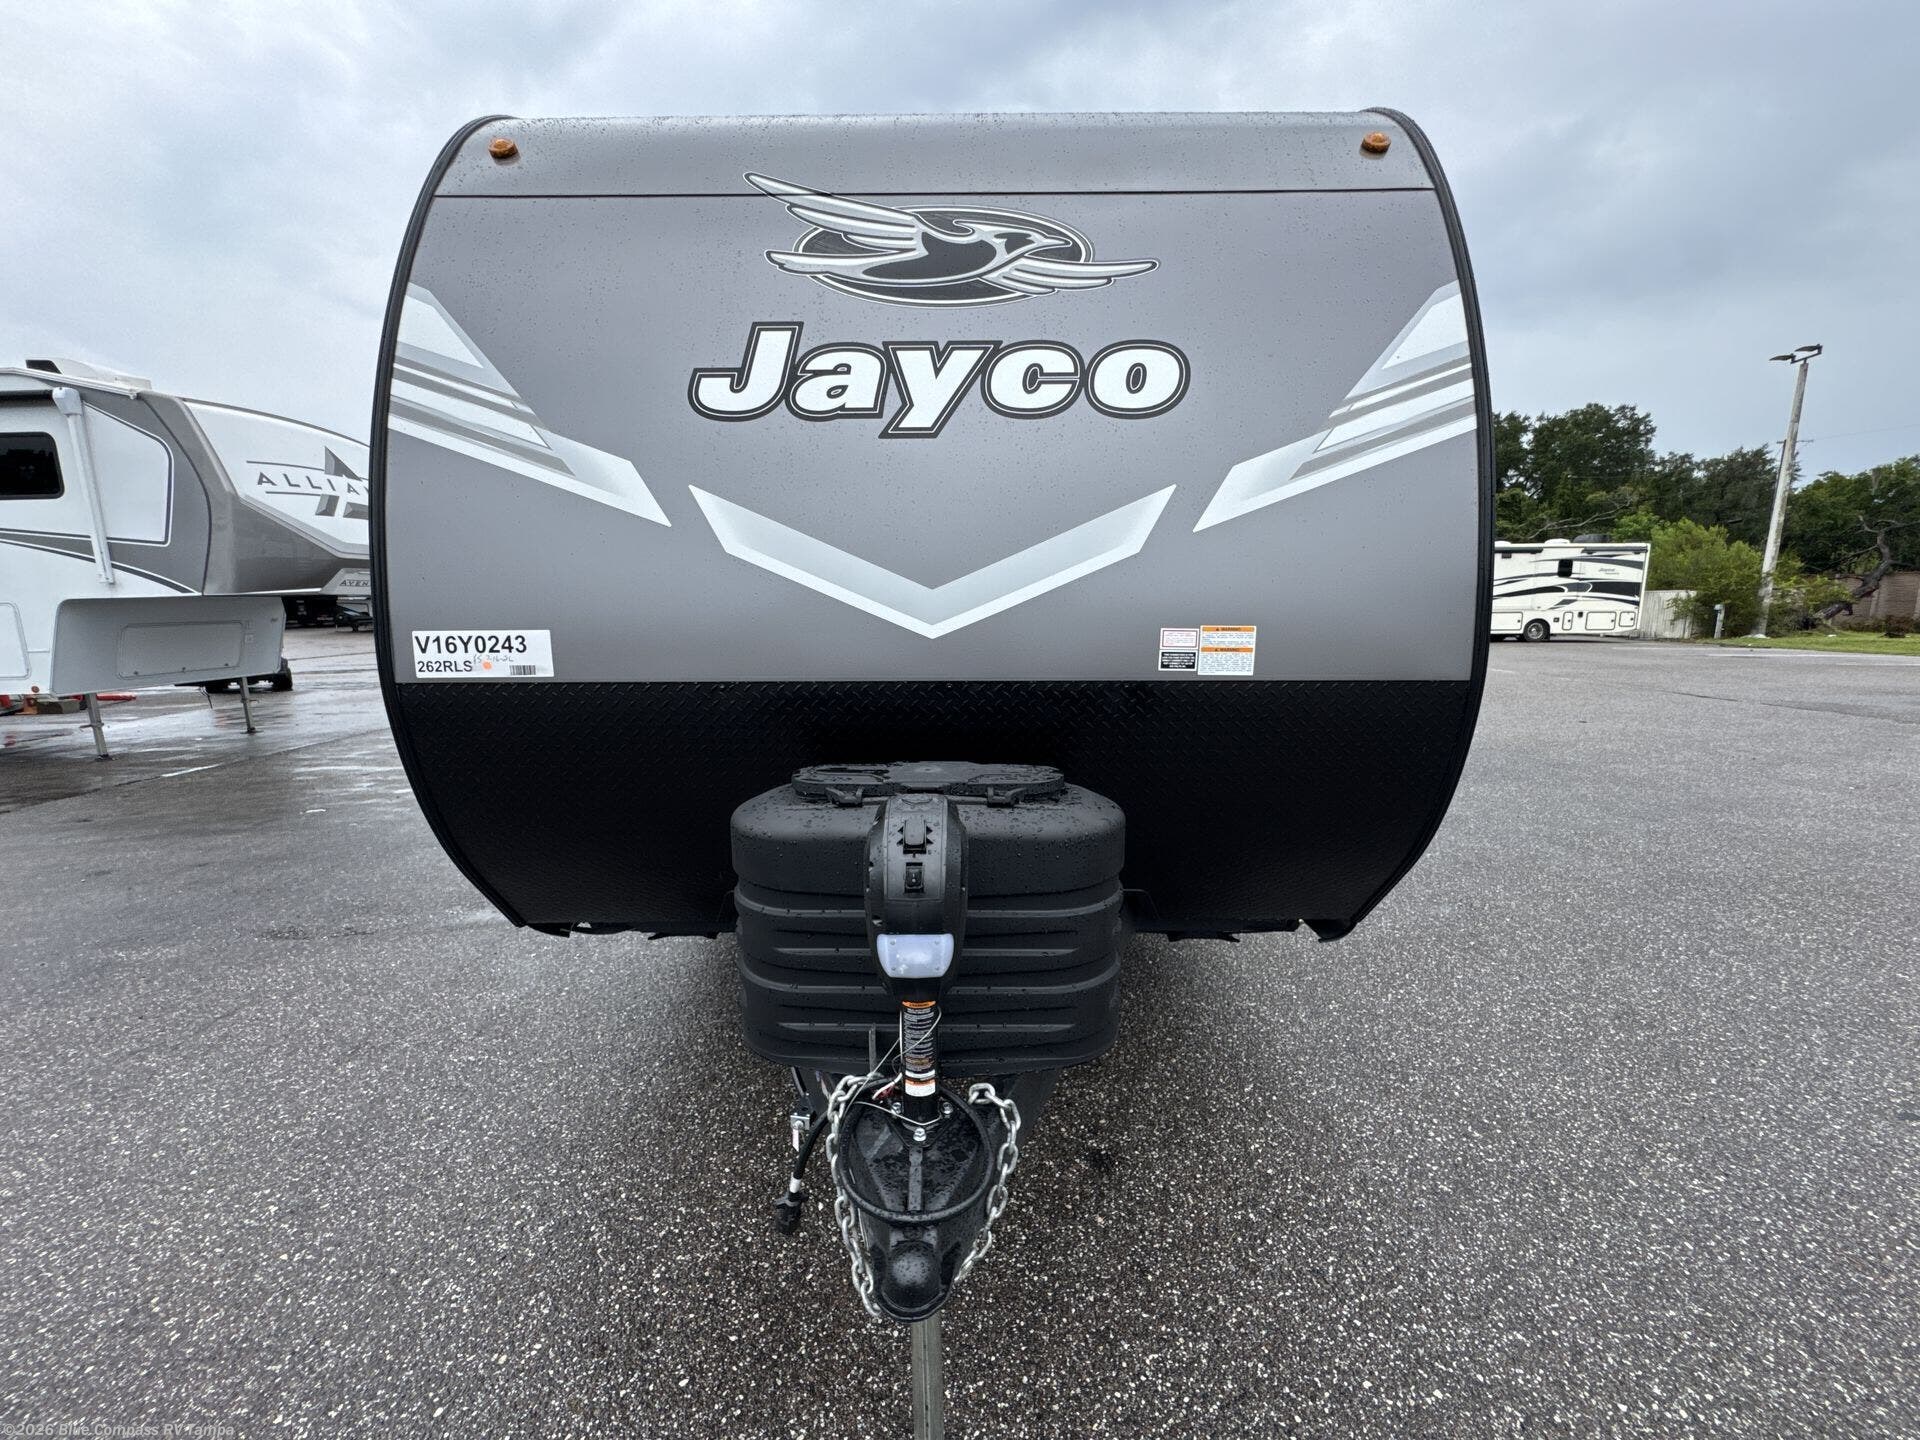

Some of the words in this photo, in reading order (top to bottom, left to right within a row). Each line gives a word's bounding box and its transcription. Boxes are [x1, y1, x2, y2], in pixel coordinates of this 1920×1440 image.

[688, 321, 1191, 439] Jayco
[257, 472, 369, 495] ALLIA
[414, 635, 527, 654] V16Y0243
[417, 660, 473, 673] 262RLS
